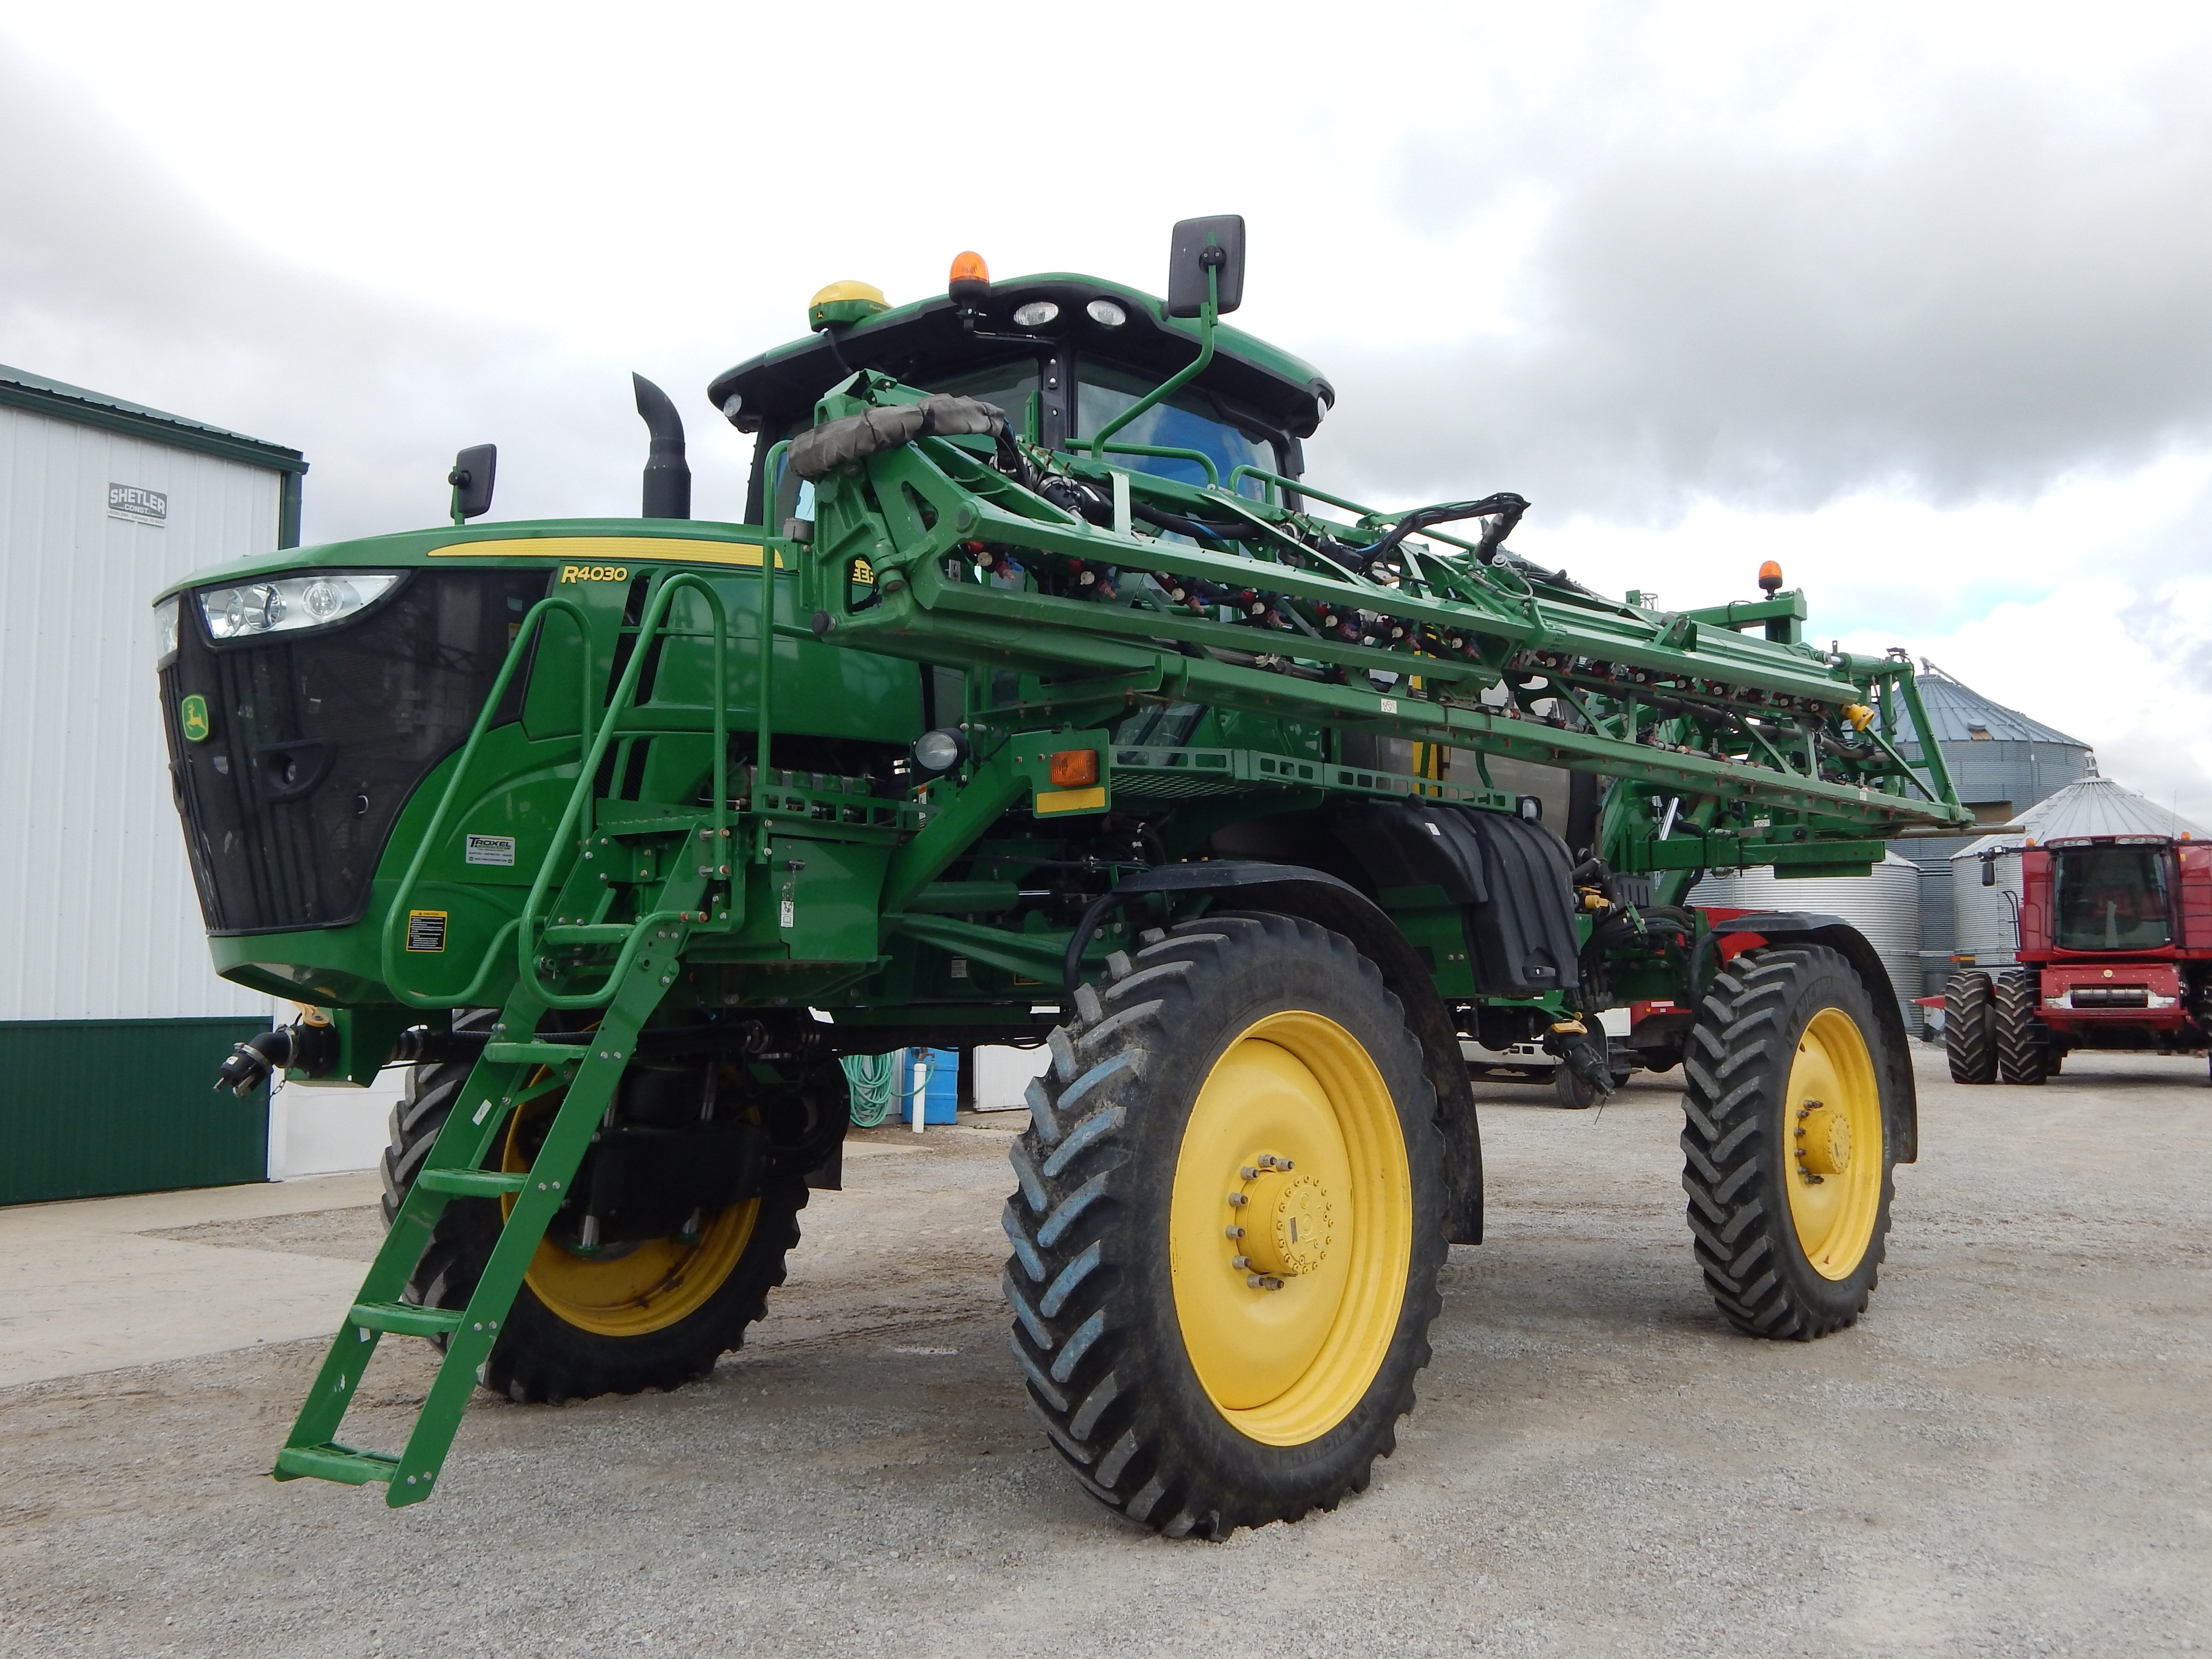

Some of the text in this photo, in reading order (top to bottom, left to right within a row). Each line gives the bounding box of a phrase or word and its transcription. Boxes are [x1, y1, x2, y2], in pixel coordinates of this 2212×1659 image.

[110, 488, 166, 515] SHETLER
[561, 565, 628, 583] R4030
[469, 837, 511, 848] TROXEL
